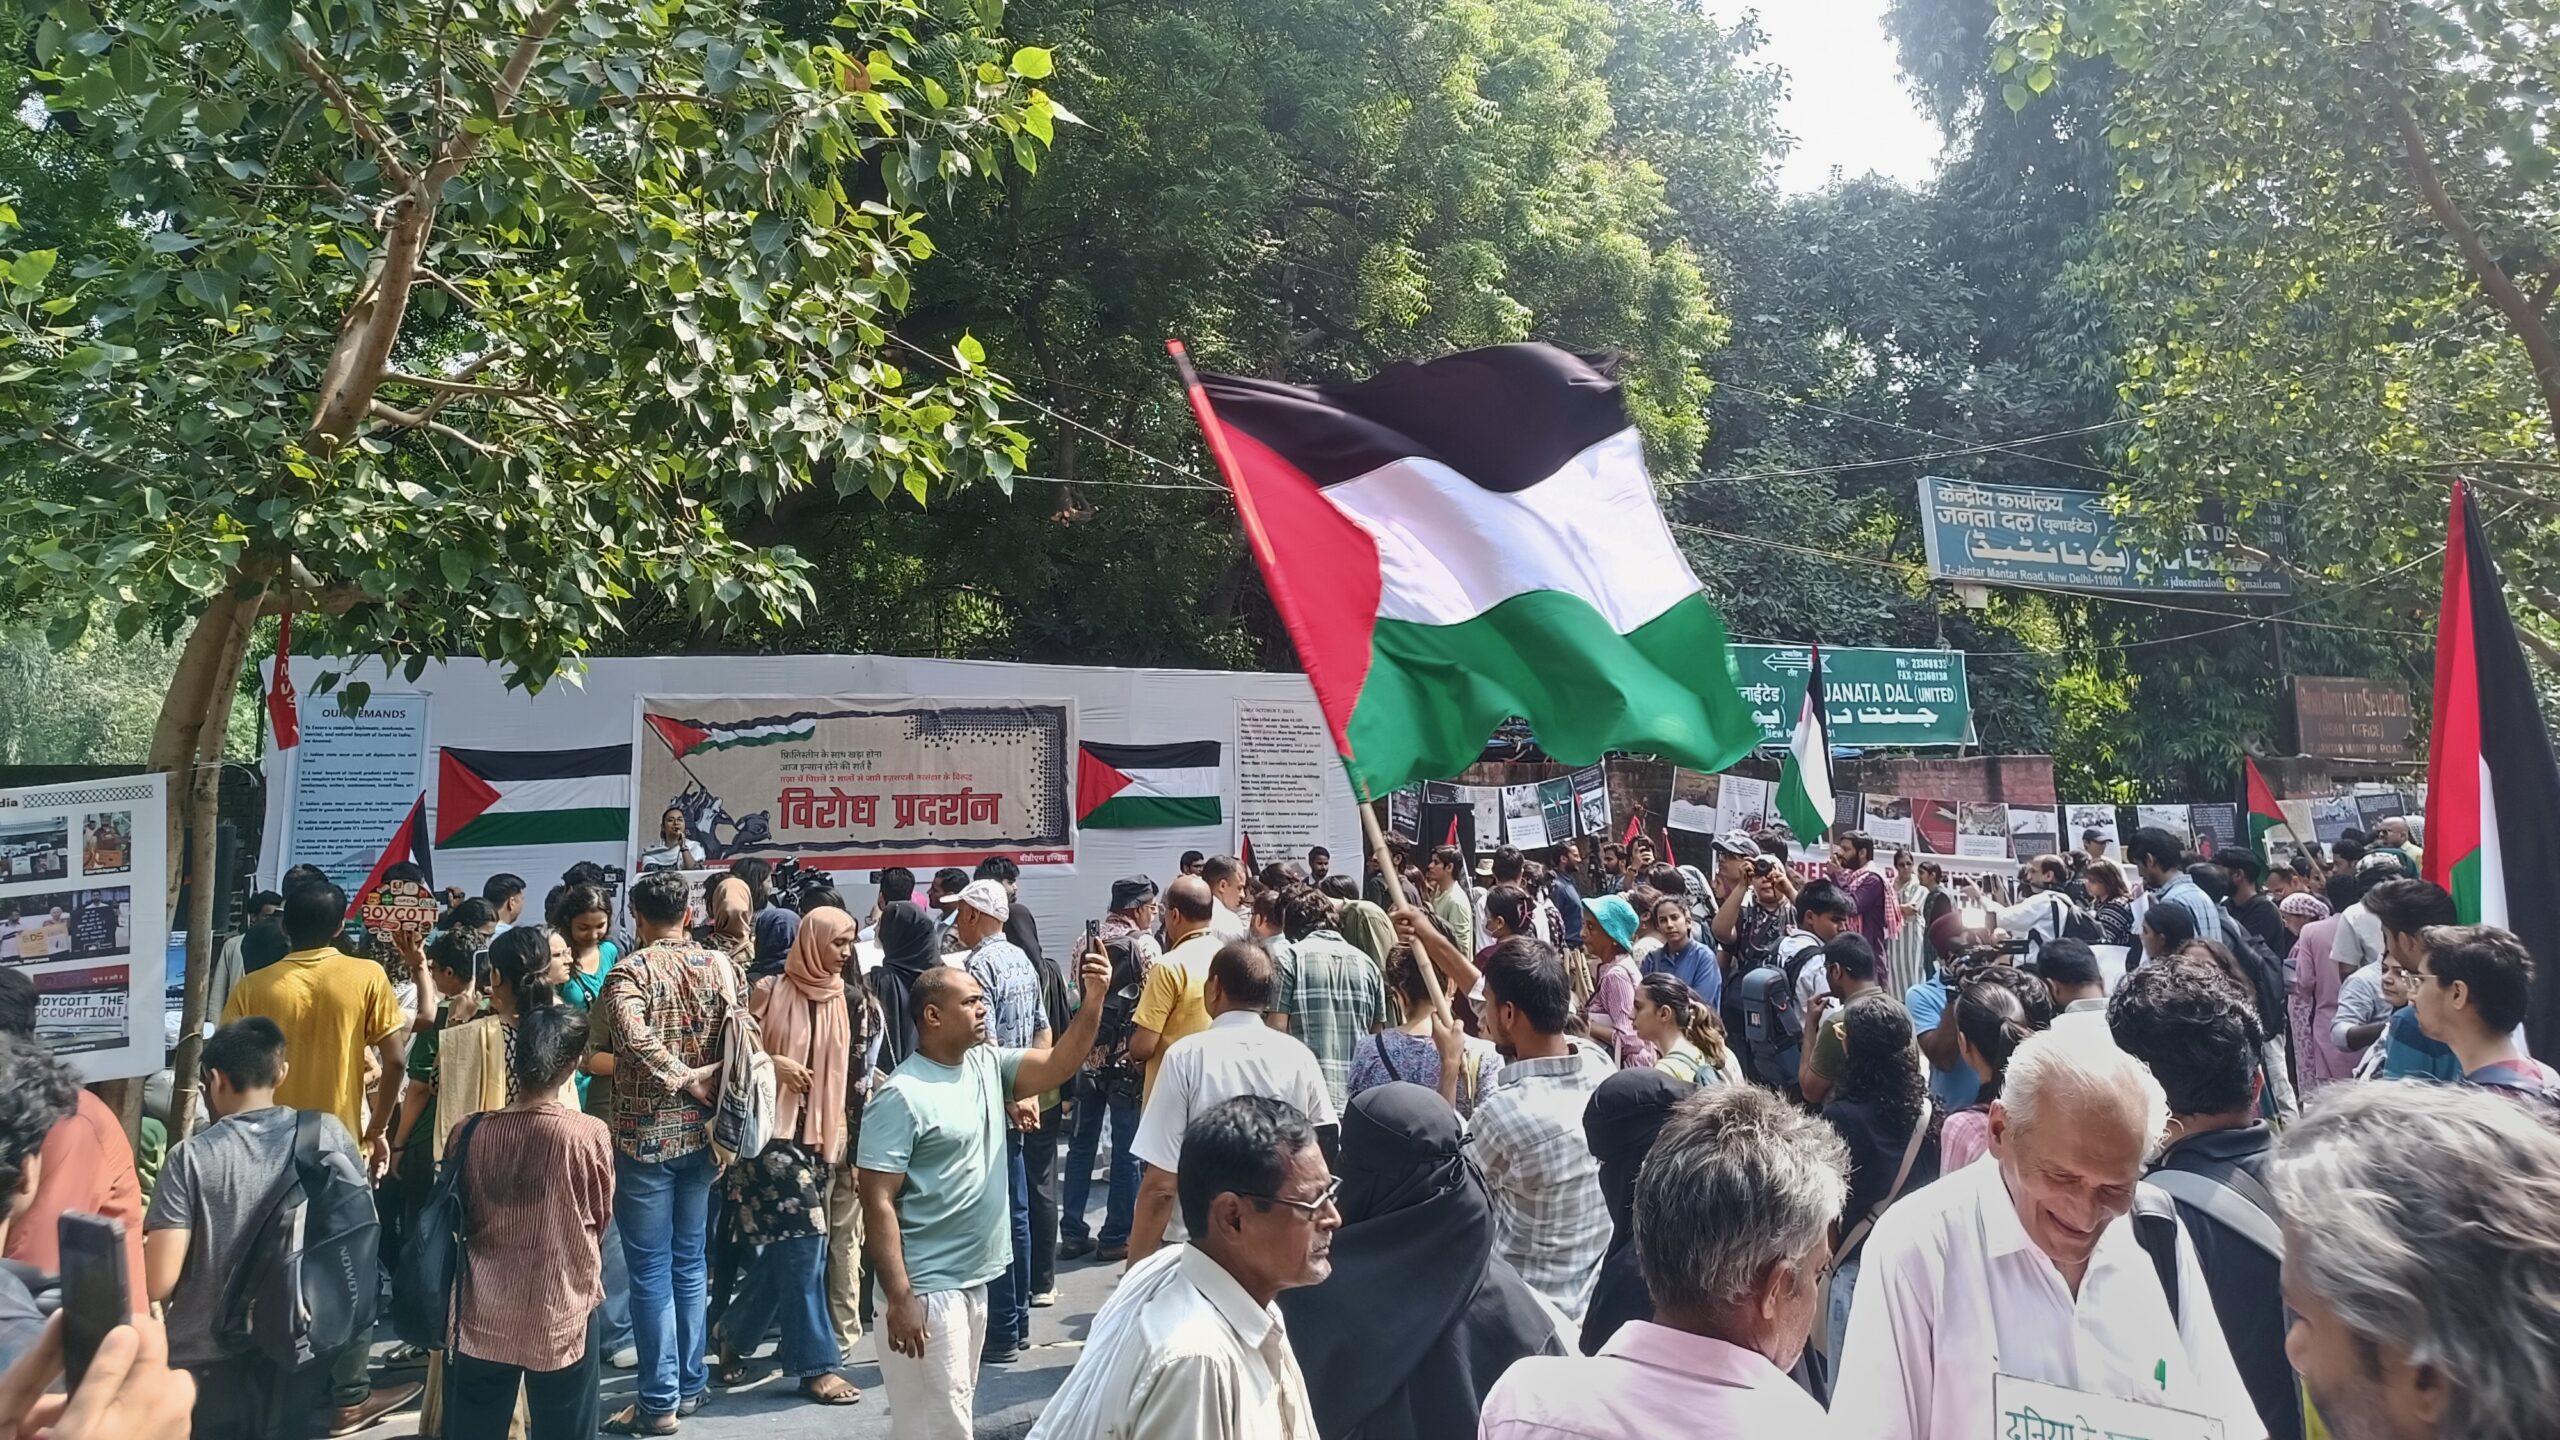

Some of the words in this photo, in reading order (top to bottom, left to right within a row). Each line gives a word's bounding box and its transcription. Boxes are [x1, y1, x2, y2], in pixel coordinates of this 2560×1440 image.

[1936, 505, 1996, 529] जनता
[2000, 511, 2035, 532] दल
[1956, 565, 1985, 577] Jantar
[1987, 568, 2018, 581] Mantar
[2020, 570, 2047, 583] Road,
[2048, 573, 2067, 584] New
[2069, 573, 2123, 587] Delhi-110001
[1823, 683, 1881, 703] JANATA
[1885, 684, 1914, 703] DAL
[1914, 686, 1958, 705] (UNITED)
[358, 709, 406, 719] EMANDS
[777, 786, 880, 829] विरोध
[891, 786, 1003, 829] प्रदर्शन
[1794, 861, 1828, 881] REE
[362, 906, 439, 921] BOYCOTT
[99, 995, 125, 1006] THE
[338, 1245, 360, 1309] ALOMON
